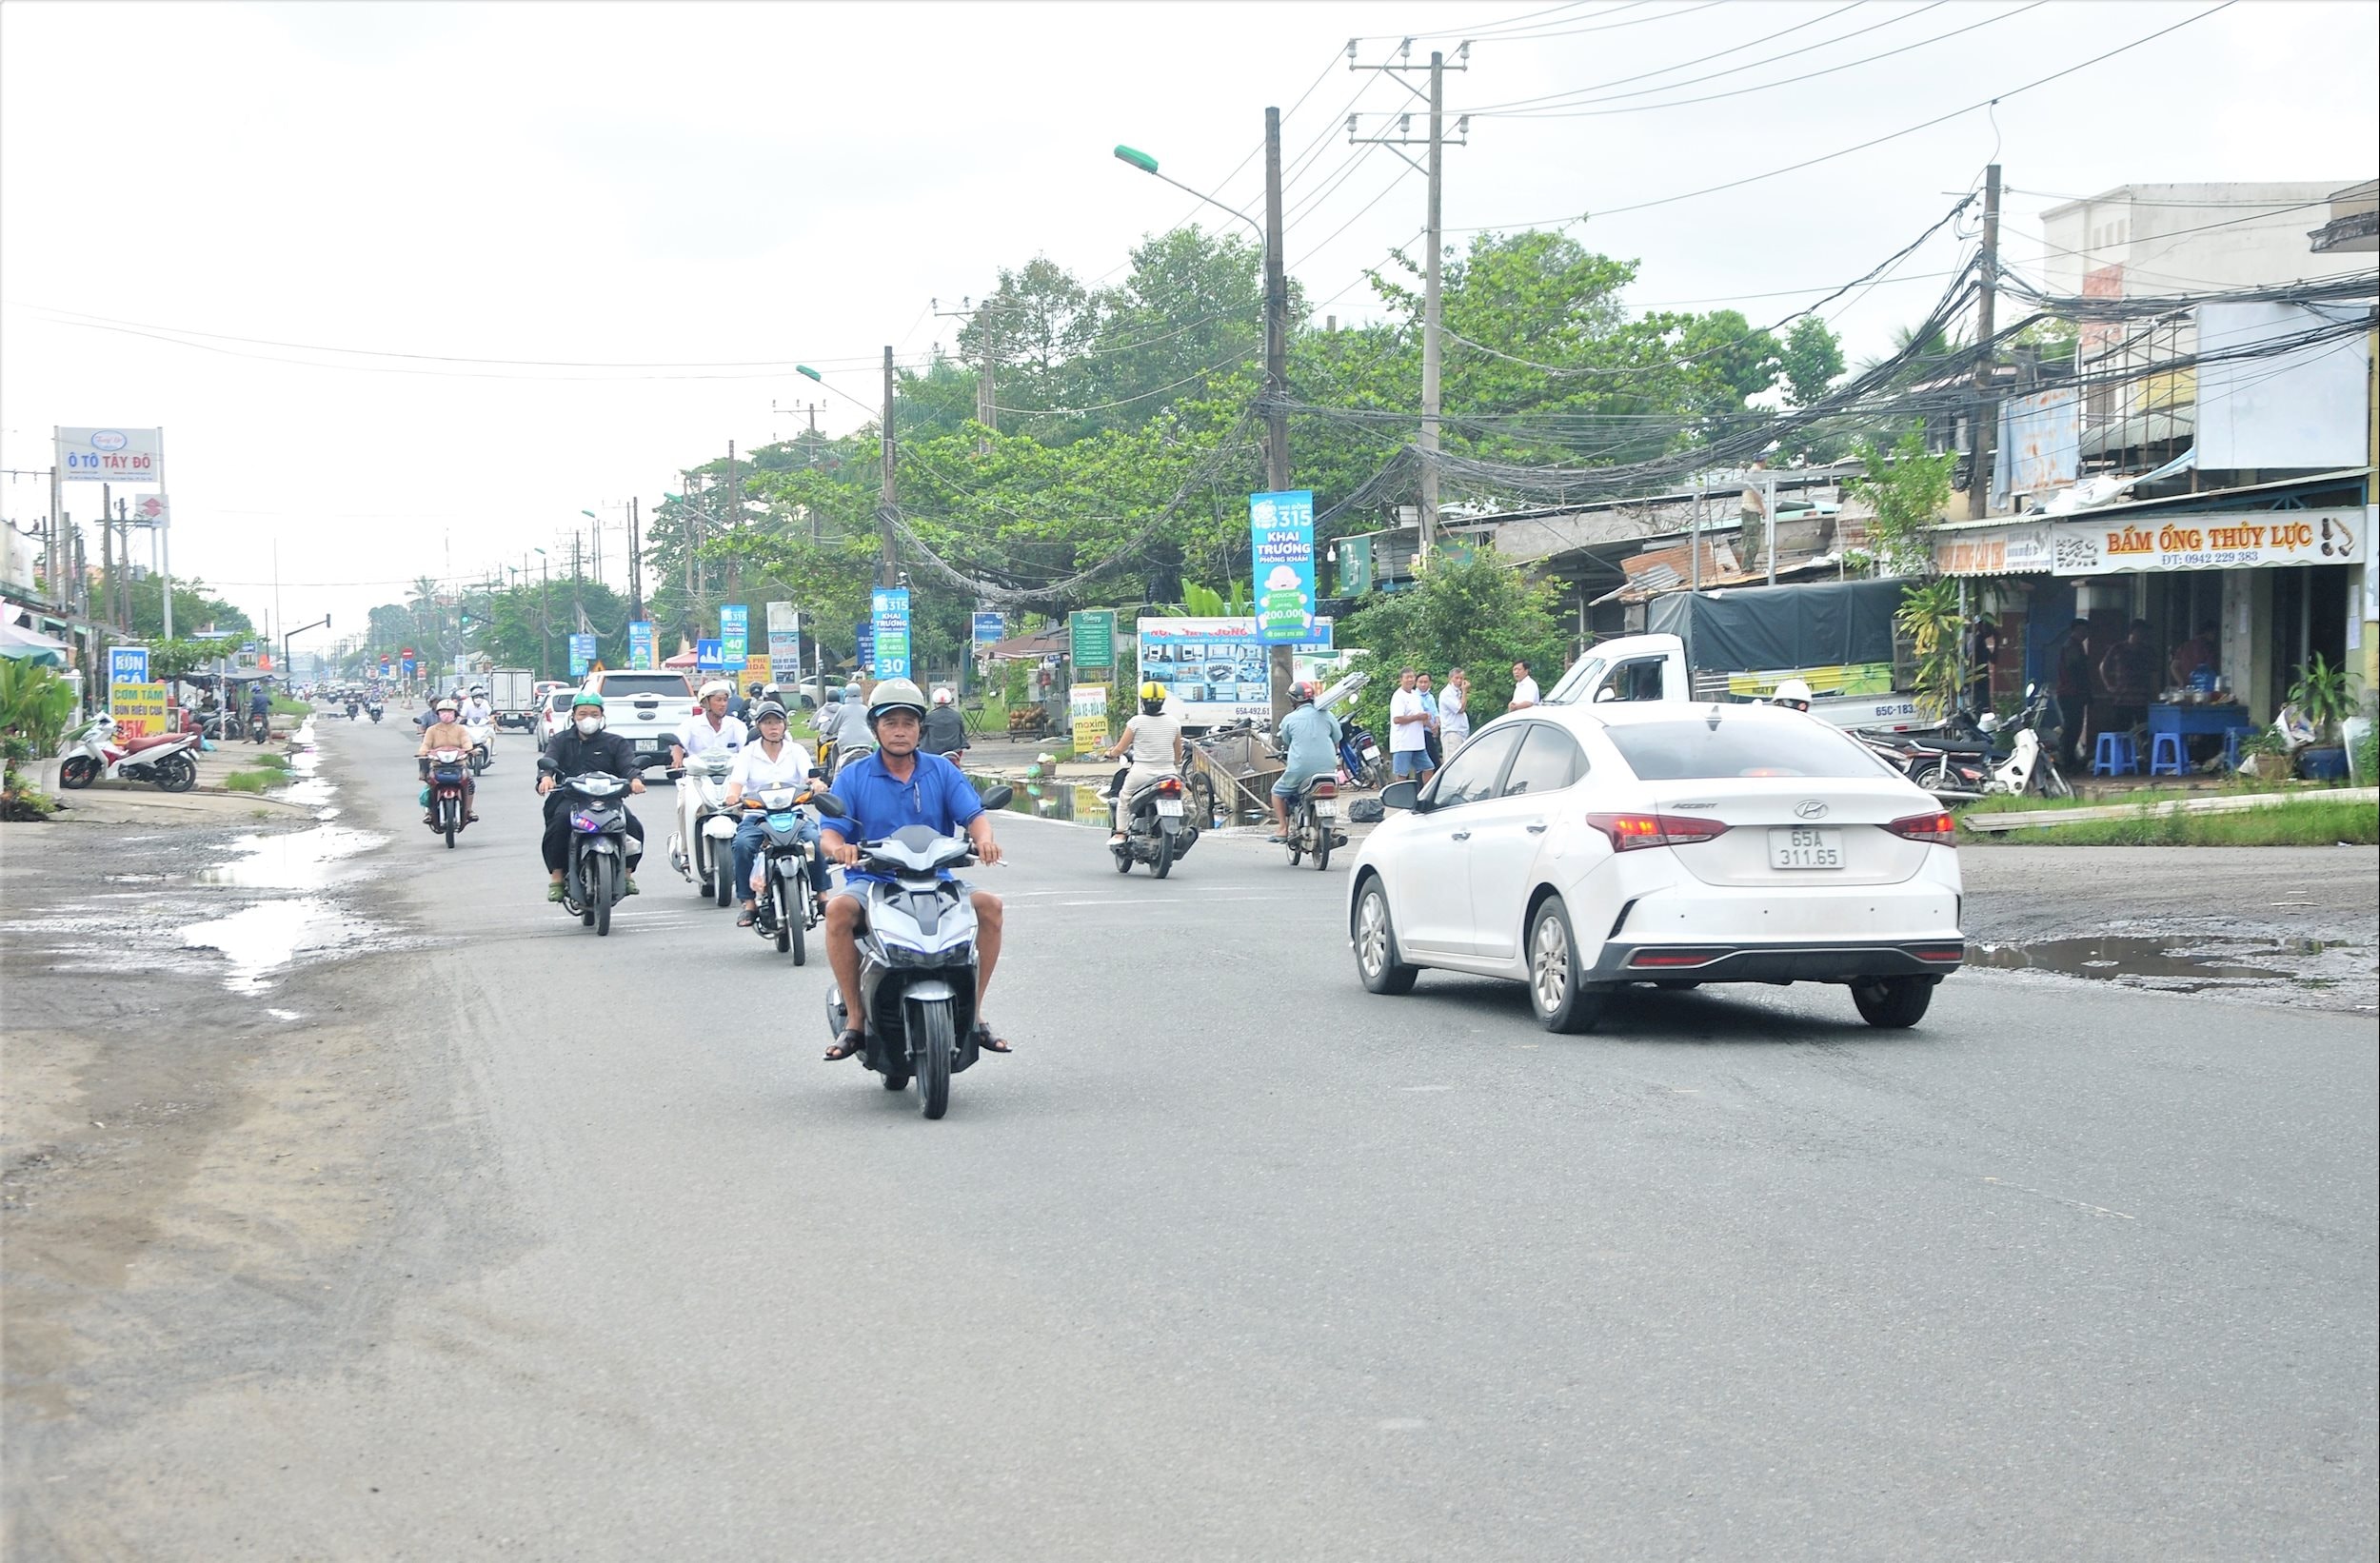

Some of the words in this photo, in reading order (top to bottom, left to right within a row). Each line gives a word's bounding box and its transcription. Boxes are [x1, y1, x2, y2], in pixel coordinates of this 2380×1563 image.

[69, 451, 78, 468] Ô
[81, 451, 99, 468] TÔ
[102, 452, 129, 468] TÂY
[132, 452, 151, 469] ĐÔ
[1279, 509, 1312, 528] 315
[1267, 530, 1299, 543] KHAI
[2107, 524, 2154, 555] BẤM
[2159, 523, 2203, 553] ỐNG
[2208, 520, 2266, 549] THỦY
[2271, 521, 2313, 552] LỰC
[1256, 542, 1312, 555] TRƯƠNG
[2161, 554, 2183, 566] ĐT:
[2185, 553, 2211, 564] 0942
[2214, 552, 2236, 564] 229
[2237, 551, 2258, 563] 383
[888, 600, 909, 611] 315
[732, 612, 746, 621] 315
[115, 653, 144, 671] BÚN
[114, 688, 138, 701] CƠM
[149, 704, 163, 716] CUA
[1875, 703, 1916, 717] 65C-183.
[1075, 720, 1106, 729] maxim
[1791, 831, 1823, 847] 65A
[1779, 849, 1838, 865] 311.65
